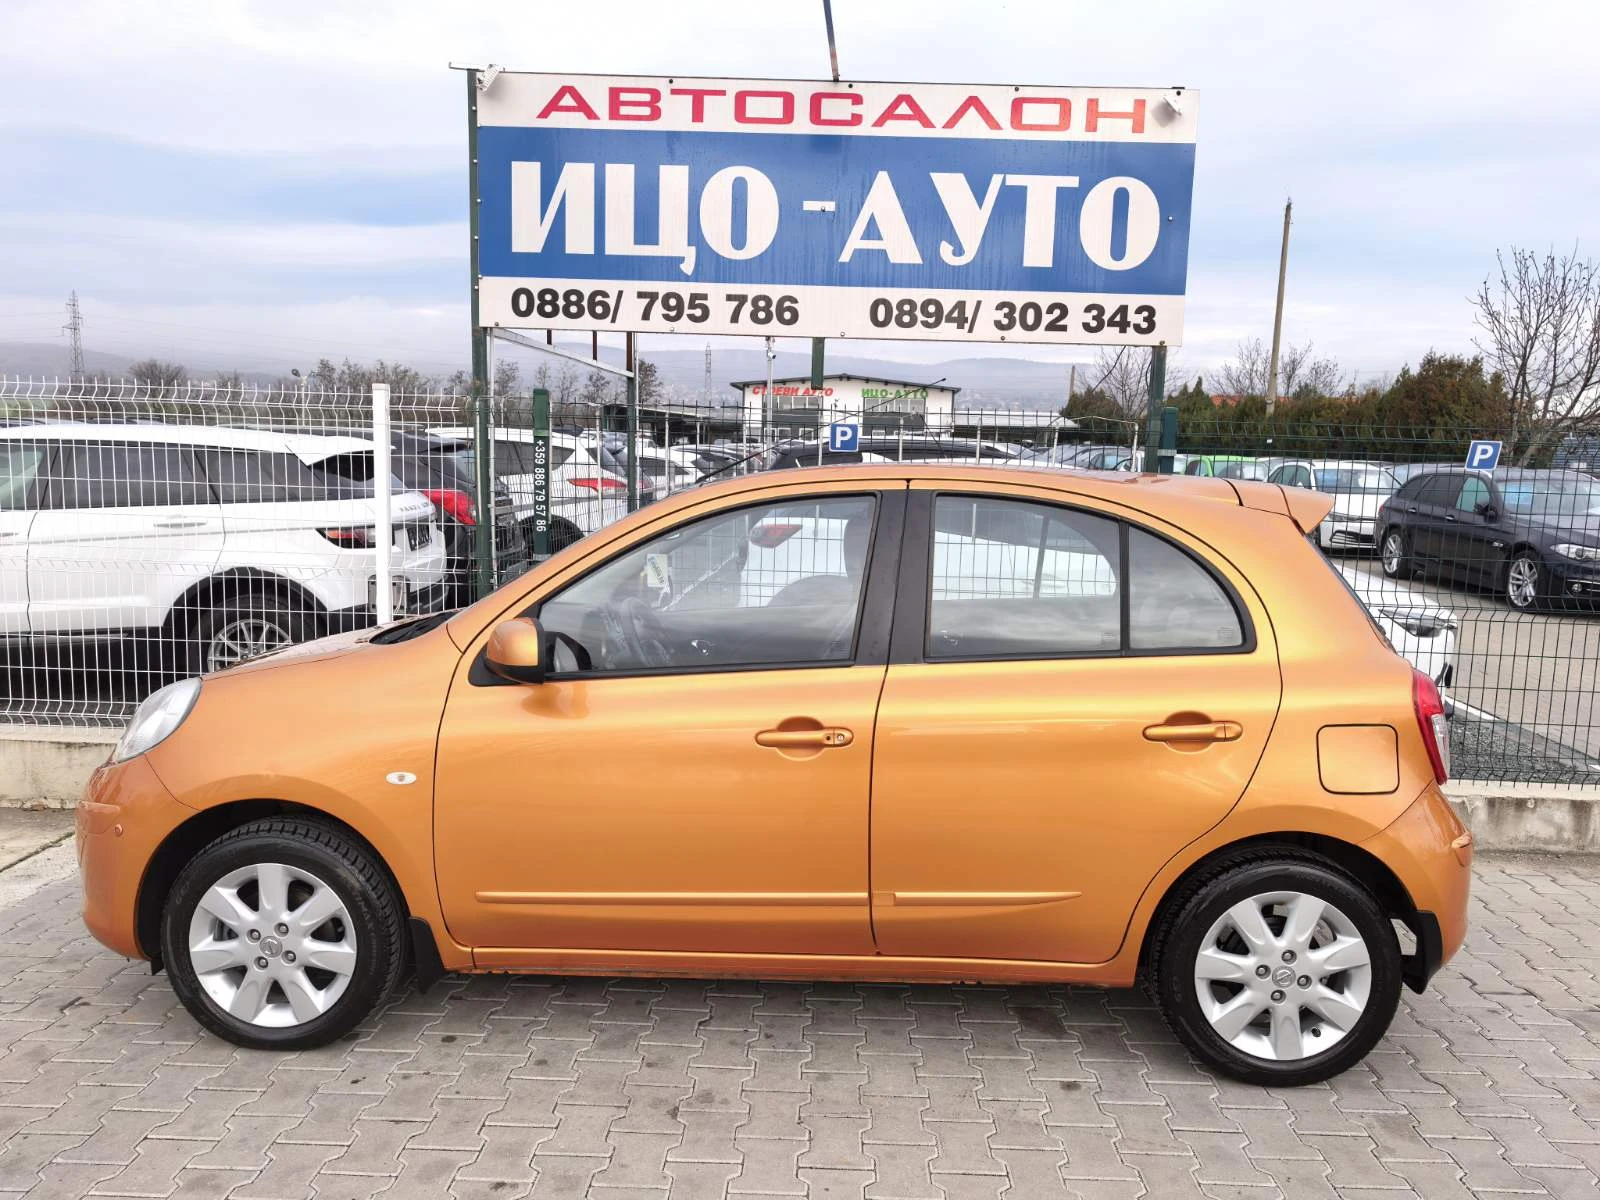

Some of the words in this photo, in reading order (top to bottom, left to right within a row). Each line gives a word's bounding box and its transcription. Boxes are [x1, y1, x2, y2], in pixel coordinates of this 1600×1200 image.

[535, 84, 1147, 134] АВТОСАЛОН
[510, 160, 780, 276] ИЦО
[511, 287, 624, 324] 0886/
[636, 291, 710, 324] 795
[725, 293, 799, 326] 786
[869, 298, 982, 334] 0894/
[993, 301, 1069, 332] 302
[1081, 303, 1156, 335] 343
[835, 426, 853, 449] P
[535, 440, 546, 465] +359
[1472, 444, 1494, 467] P
[535, 467, 546, 486] 886
[536, 488, 546, 502] 79
[536, 504, 547, 517] 57
[536, 519, 547, 532] 86
